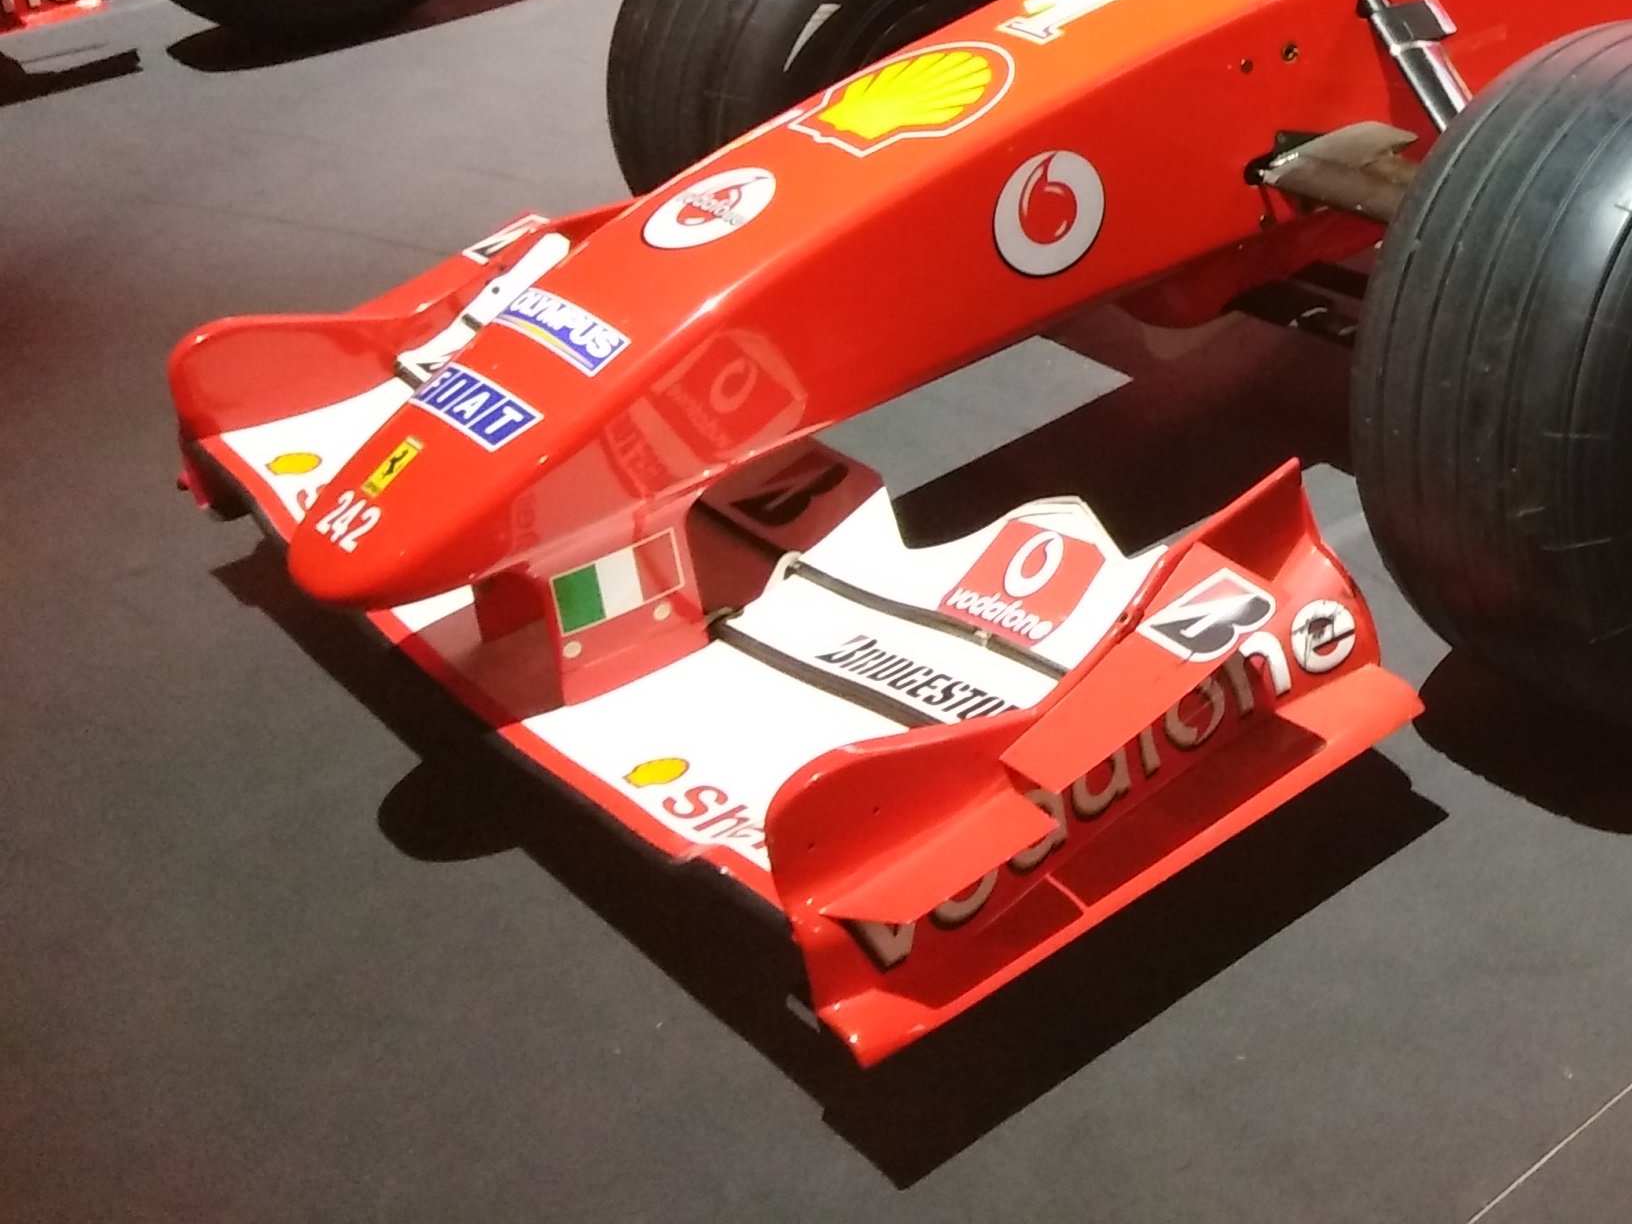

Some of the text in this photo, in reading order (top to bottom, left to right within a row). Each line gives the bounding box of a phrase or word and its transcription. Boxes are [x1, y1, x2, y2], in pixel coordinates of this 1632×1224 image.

[509, 293, 619, 358] OLYMPUS
[422, 370, 525, 435] FIAT
[315, 490, 381, 553] 242
[946, 587, 1053, 640] vodafone
[814, 634, 1021, 720] BRIDGESTO
